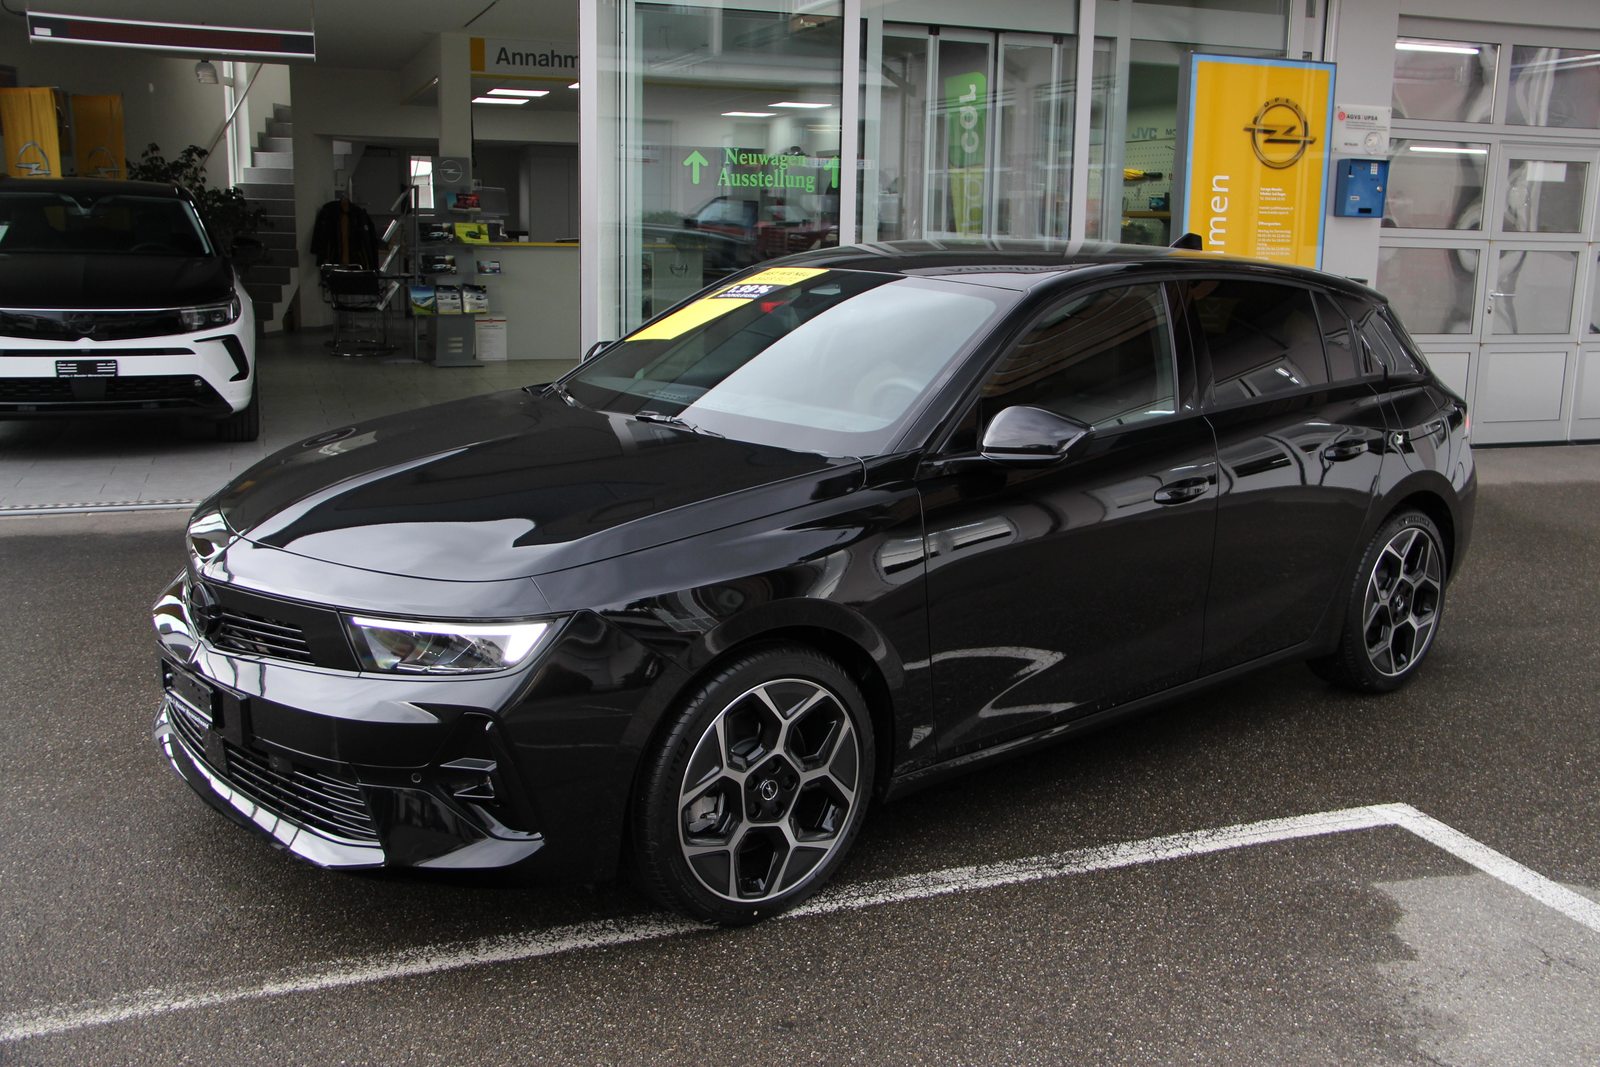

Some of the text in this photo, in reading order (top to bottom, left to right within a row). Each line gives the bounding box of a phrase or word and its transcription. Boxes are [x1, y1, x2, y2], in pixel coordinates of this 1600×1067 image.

[496, 47, 578, 68] Annahm
[1131, 127, 1158, 140] JVC
[724, 147, 808, 169] Neuwagen
[717, 168, 816, 193] Ausstellung
